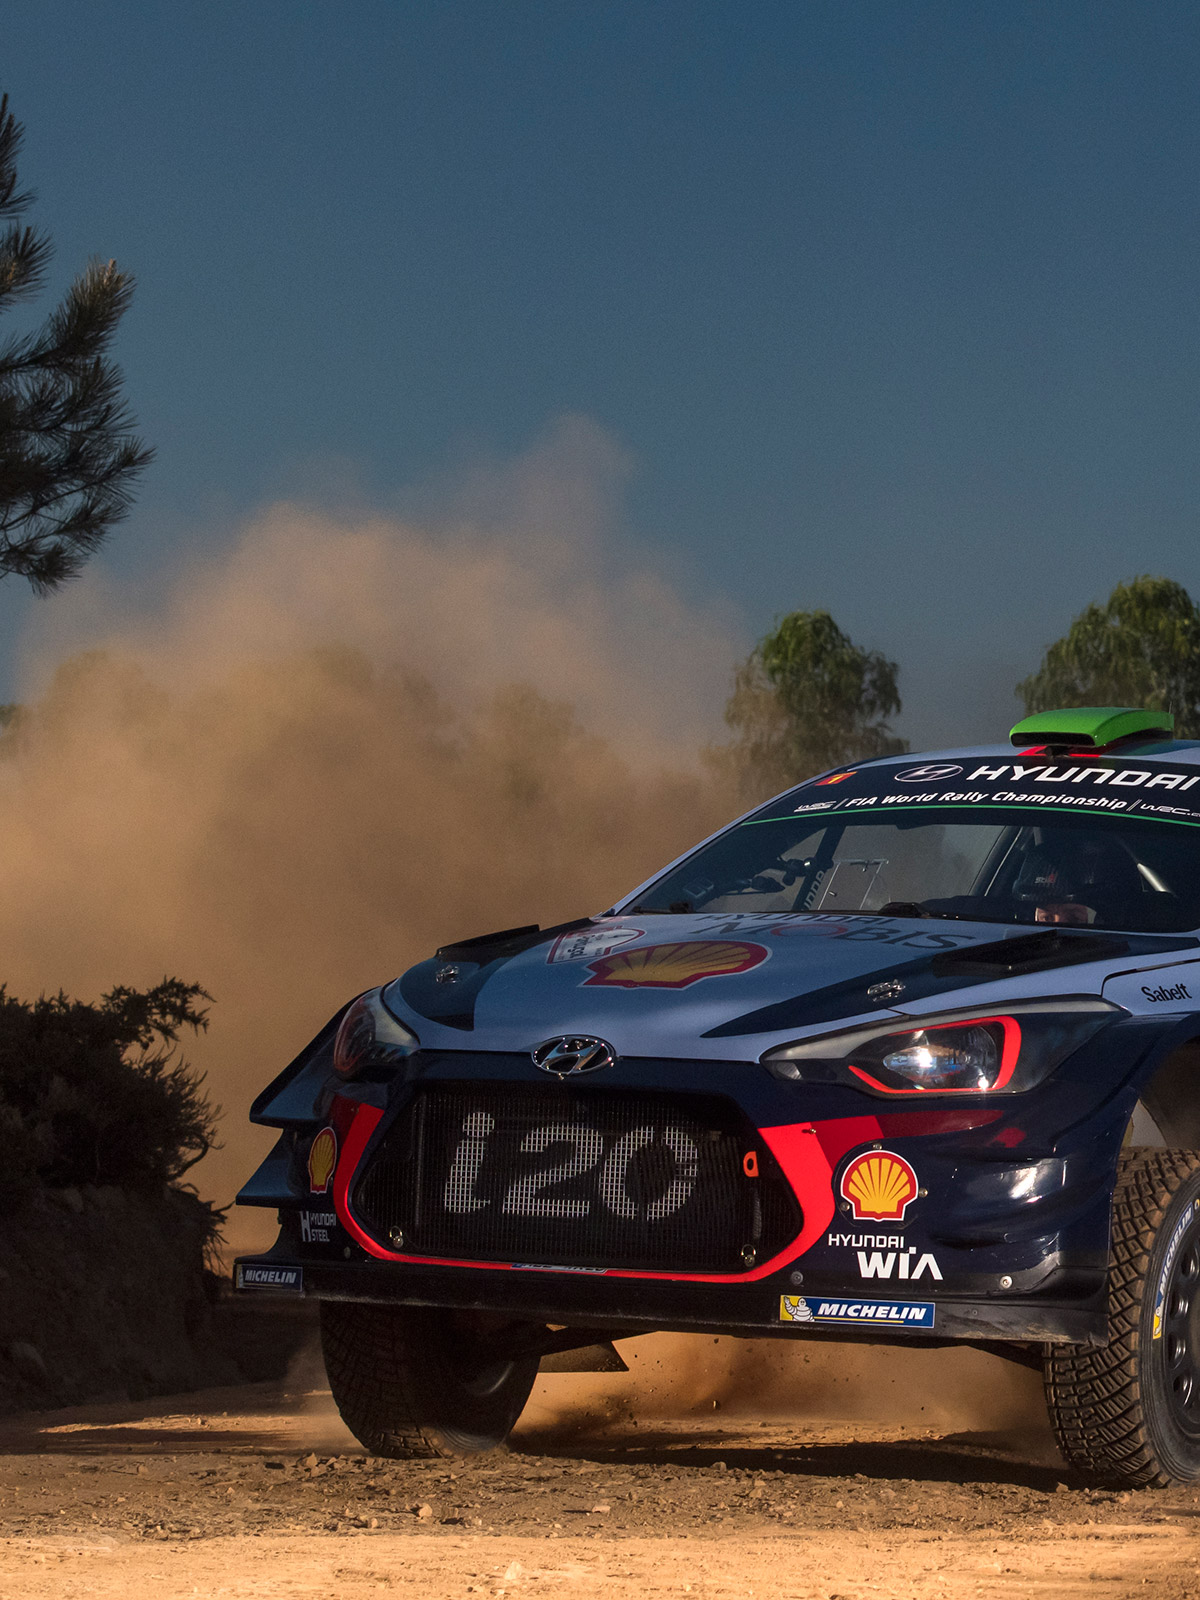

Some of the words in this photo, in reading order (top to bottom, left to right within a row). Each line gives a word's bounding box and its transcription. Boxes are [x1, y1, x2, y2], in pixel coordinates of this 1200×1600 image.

[845, 796, 880, 808] FIA
[881, 792, 938, 804] World
[938, 791, 989, 803] Rally
[991, 791, 1127, 811] Championship
[694, 913, 898, 926] HYUNDAI
[688, 921, 977, 950] MOBIS
[1141, 983, 1193, 1003] Sabelt
[310, 1212, 337, 1227] HYUNDAI
[311, 1228, 330, 1242] STEEL
[828, 1233, 905, 1249] HYUNDAI
[1159, 1207, 1192, 1296] MICHELIN
[245, 1269, 297, 1284] MICHELIN
[817, 1302, 927, 1321] MICHELIN
